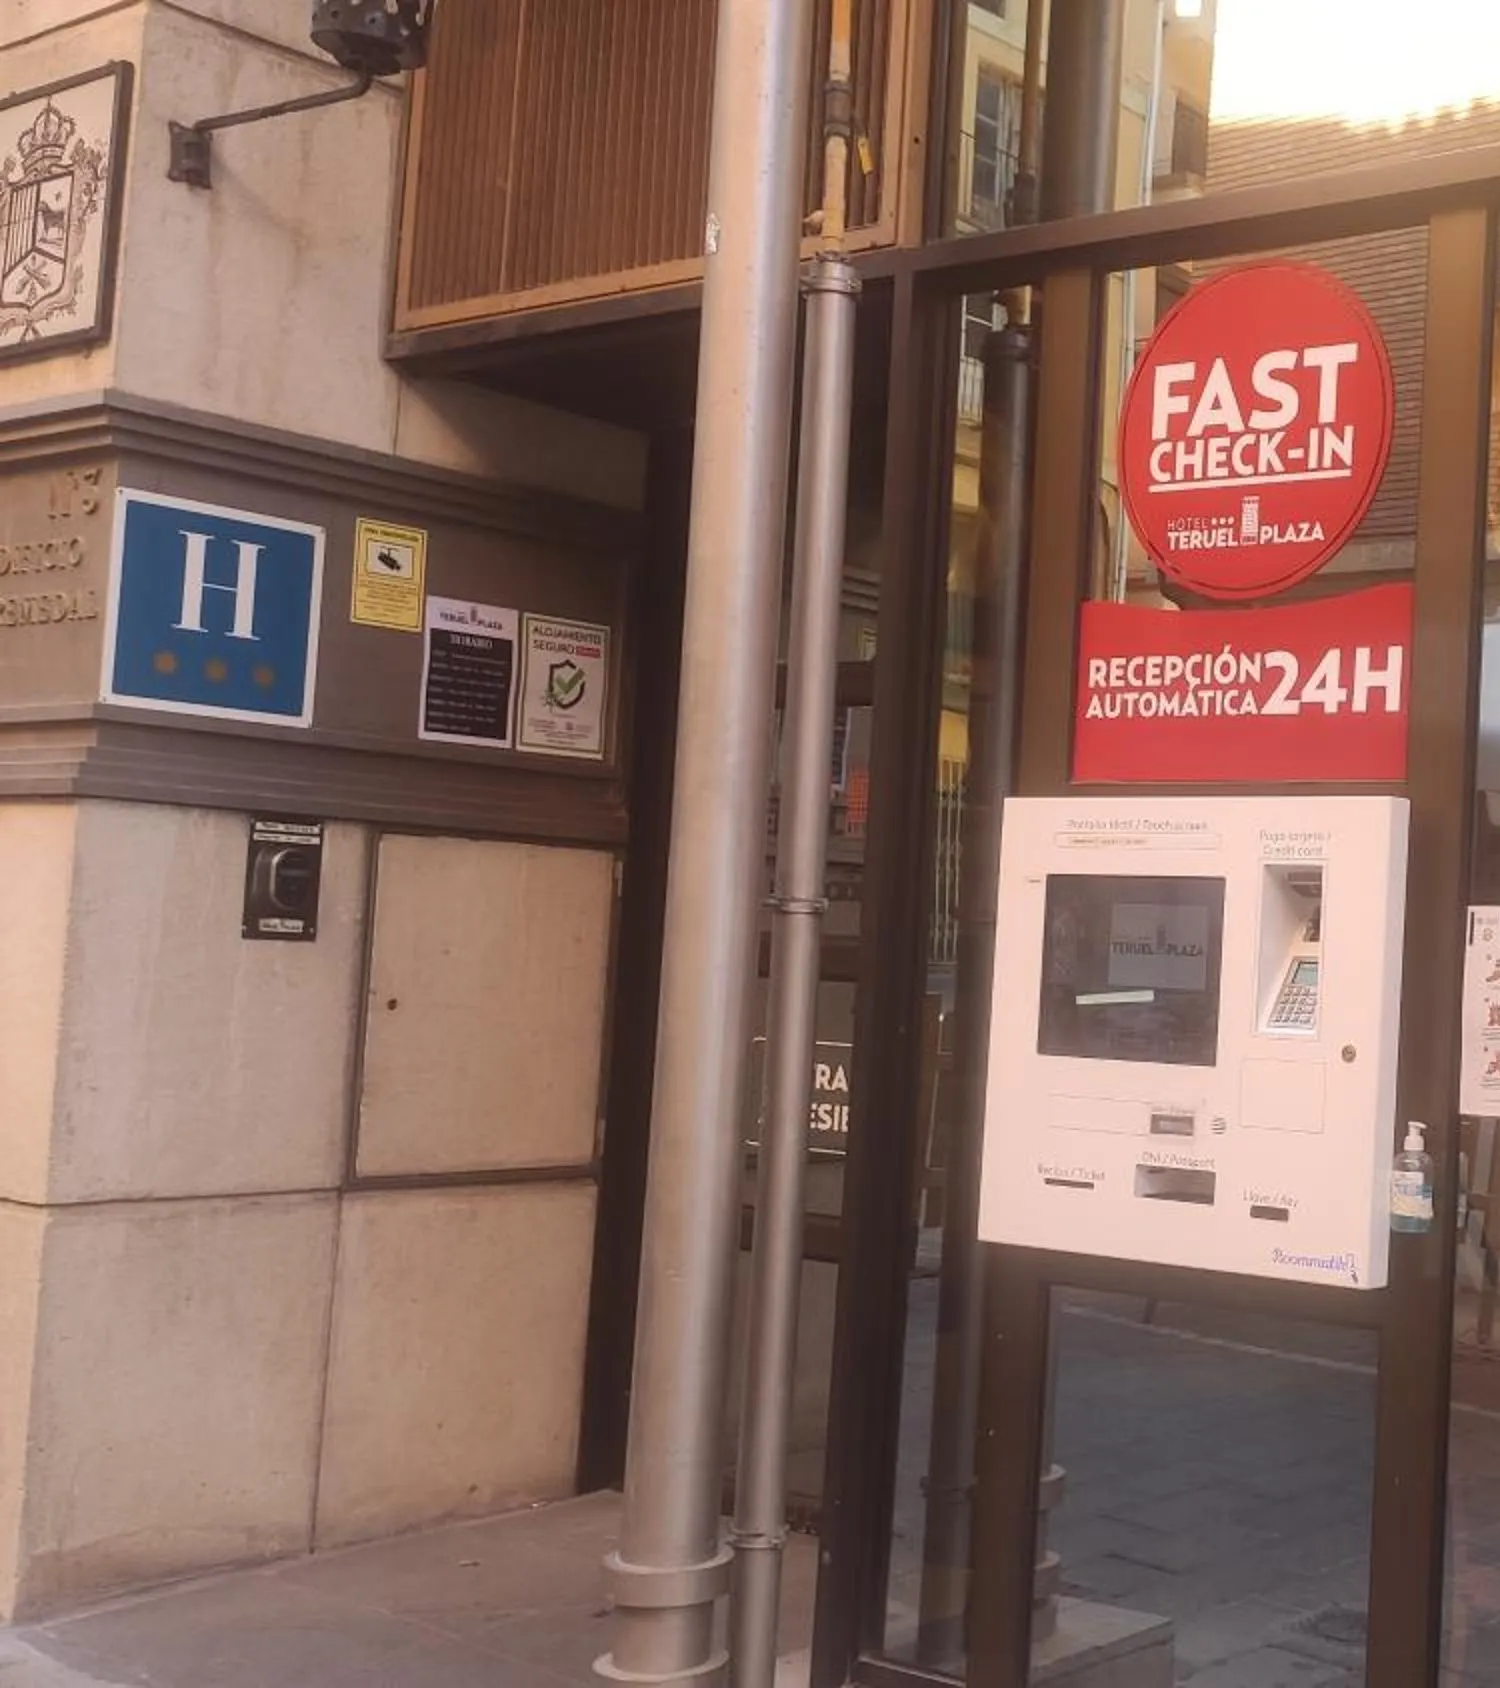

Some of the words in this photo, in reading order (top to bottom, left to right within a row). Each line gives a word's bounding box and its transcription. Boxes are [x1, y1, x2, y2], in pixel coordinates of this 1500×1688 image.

[1152, 343, 1359, 440] FAST
[1150, 425, 1355, 483] CHECK-IN
[1167, 517, 1209, 531] HOTEL
[1167, 527, 1240, 551] TERUEL
[1259, 521, 1326, 545] PLAZA
[171, 529, 267, 641] H
[533, 639, 576, 655] SEGURO
[1085, 682, 1261, 720] AUTOMÁTICA
[1088, 644, 1262, 689] RECEPCIÓN
[1260, 645, 1404, 716] 24H
